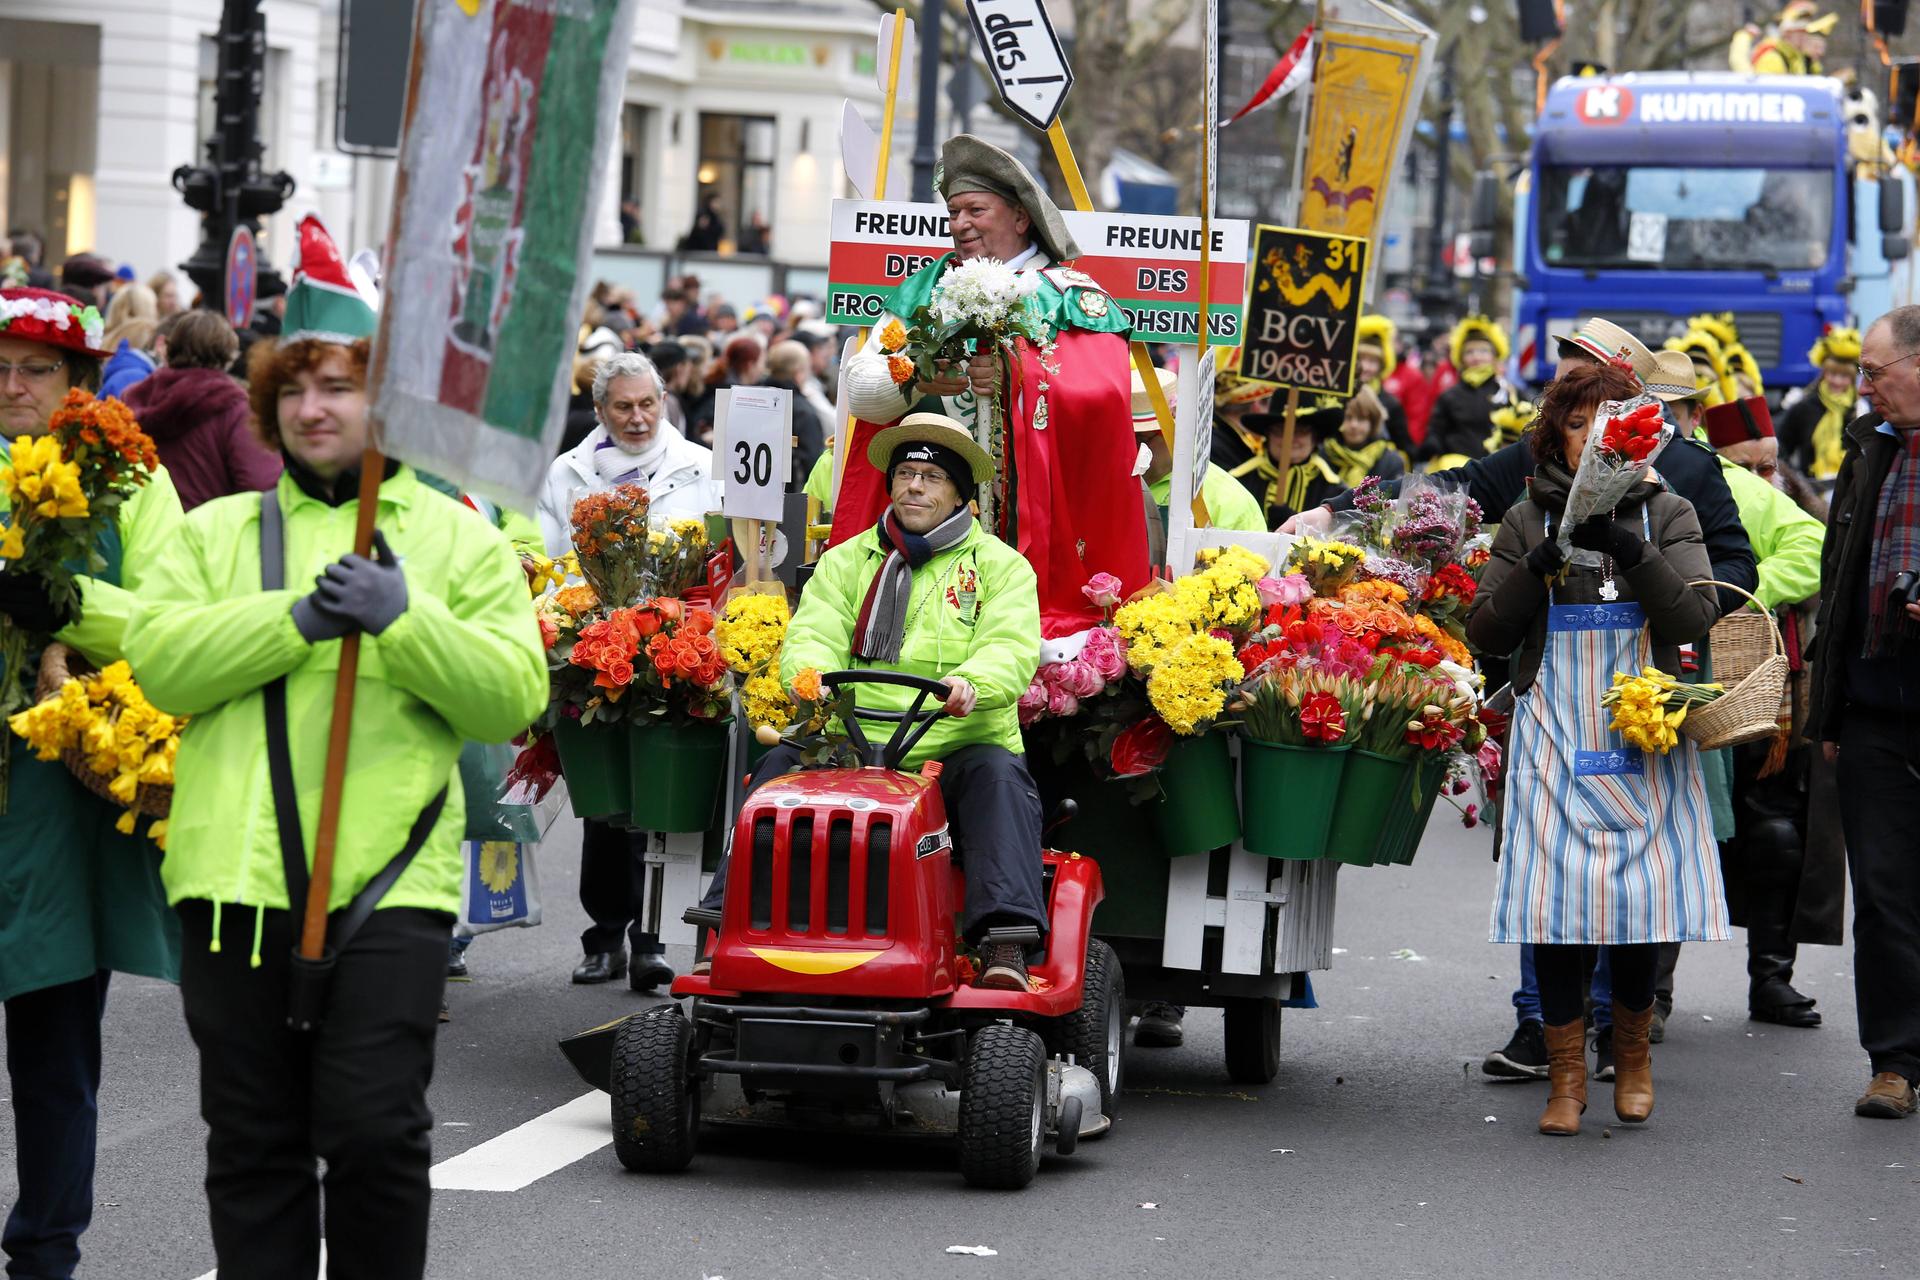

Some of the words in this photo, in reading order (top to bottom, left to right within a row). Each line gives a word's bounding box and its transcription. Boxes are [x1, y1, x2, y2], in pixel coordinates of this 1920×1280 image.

[985, 13, 1064, 86] das!
[1640, 92, 1806, 123] KUMMER
[855, 212, 953, 238] FREUND
[1106, 225, 1224, 252] FREUNDE
[1324, 239, 1360, 273] 31
[1137, 267, 1189, 292] DES
[1258, 308, 1346, 352] BCV
[733, 440, 773, 488] 30
